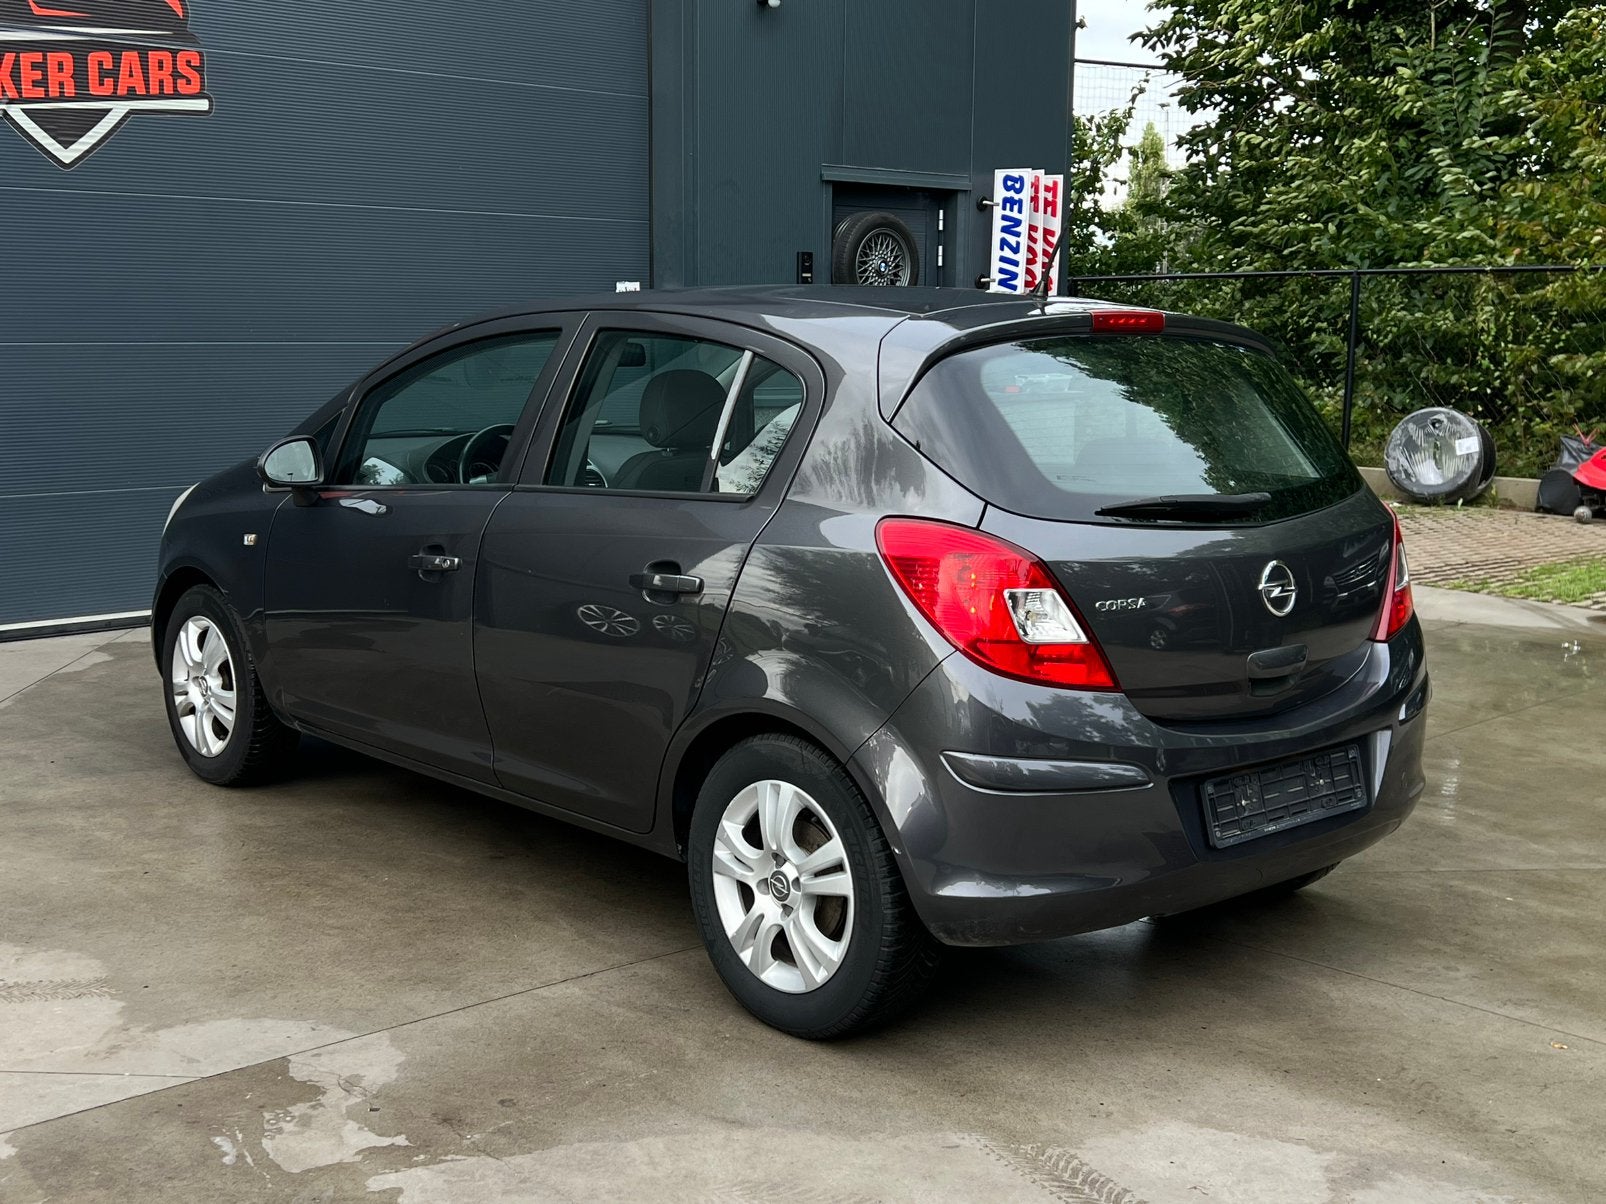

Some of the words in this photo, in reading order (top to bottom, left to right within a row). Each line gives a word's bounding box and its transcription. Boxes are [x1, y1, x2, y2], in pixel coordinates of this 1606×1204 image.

[87, 50, 201, 96] CARS
[997, 174, 1025, 292] BENZIN
[1095, 597, 1147, 611] CORSA
